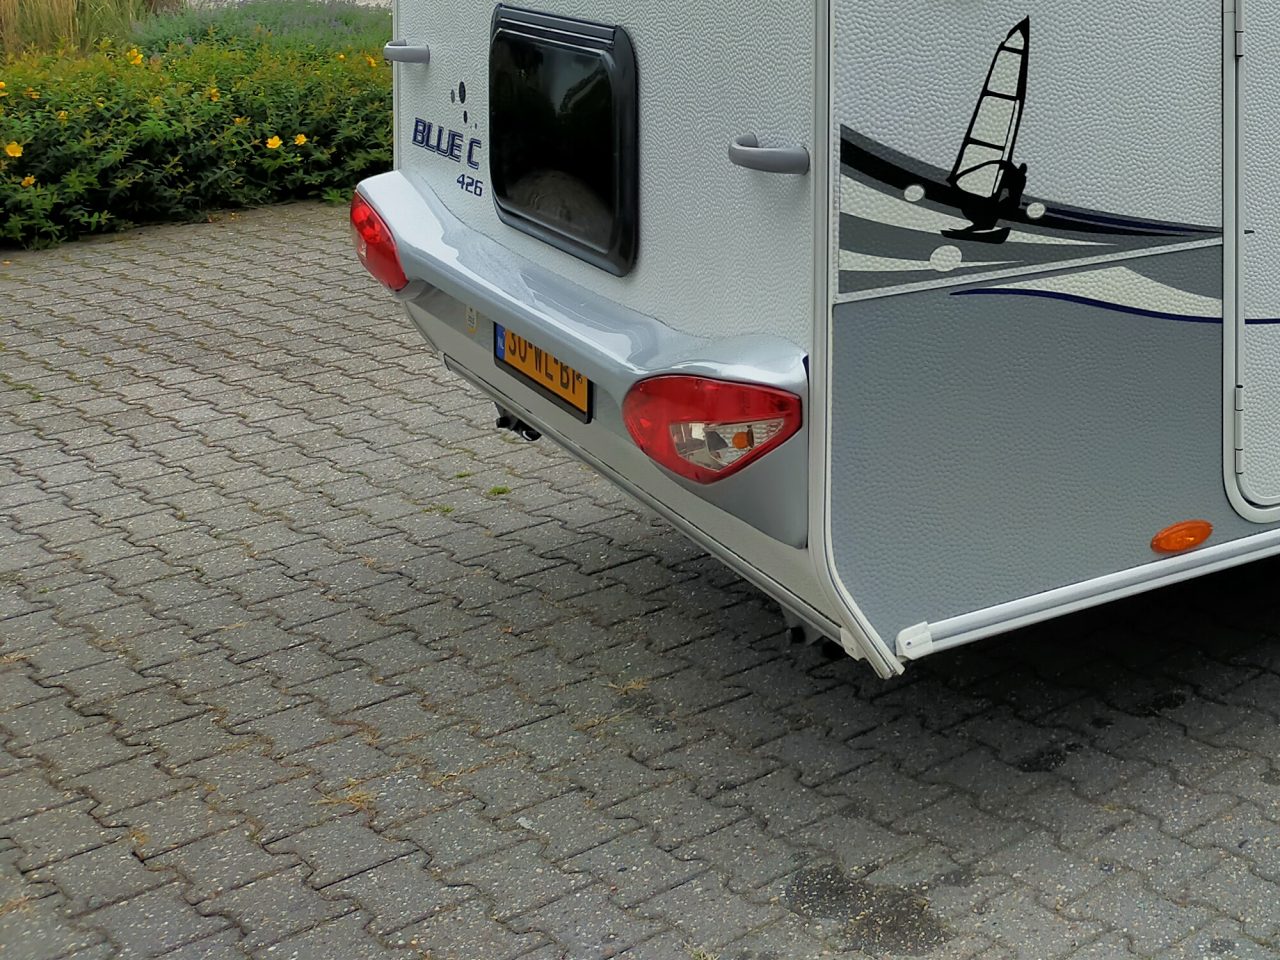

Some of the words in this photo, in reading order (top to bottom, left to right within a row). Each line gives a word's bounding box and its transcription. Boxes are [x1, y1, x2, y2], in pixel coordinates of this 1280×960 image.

[412, 117, 464, 163] BLUE
[467, 137, 482, 171] C
[456, 173, 484, 198] 426
